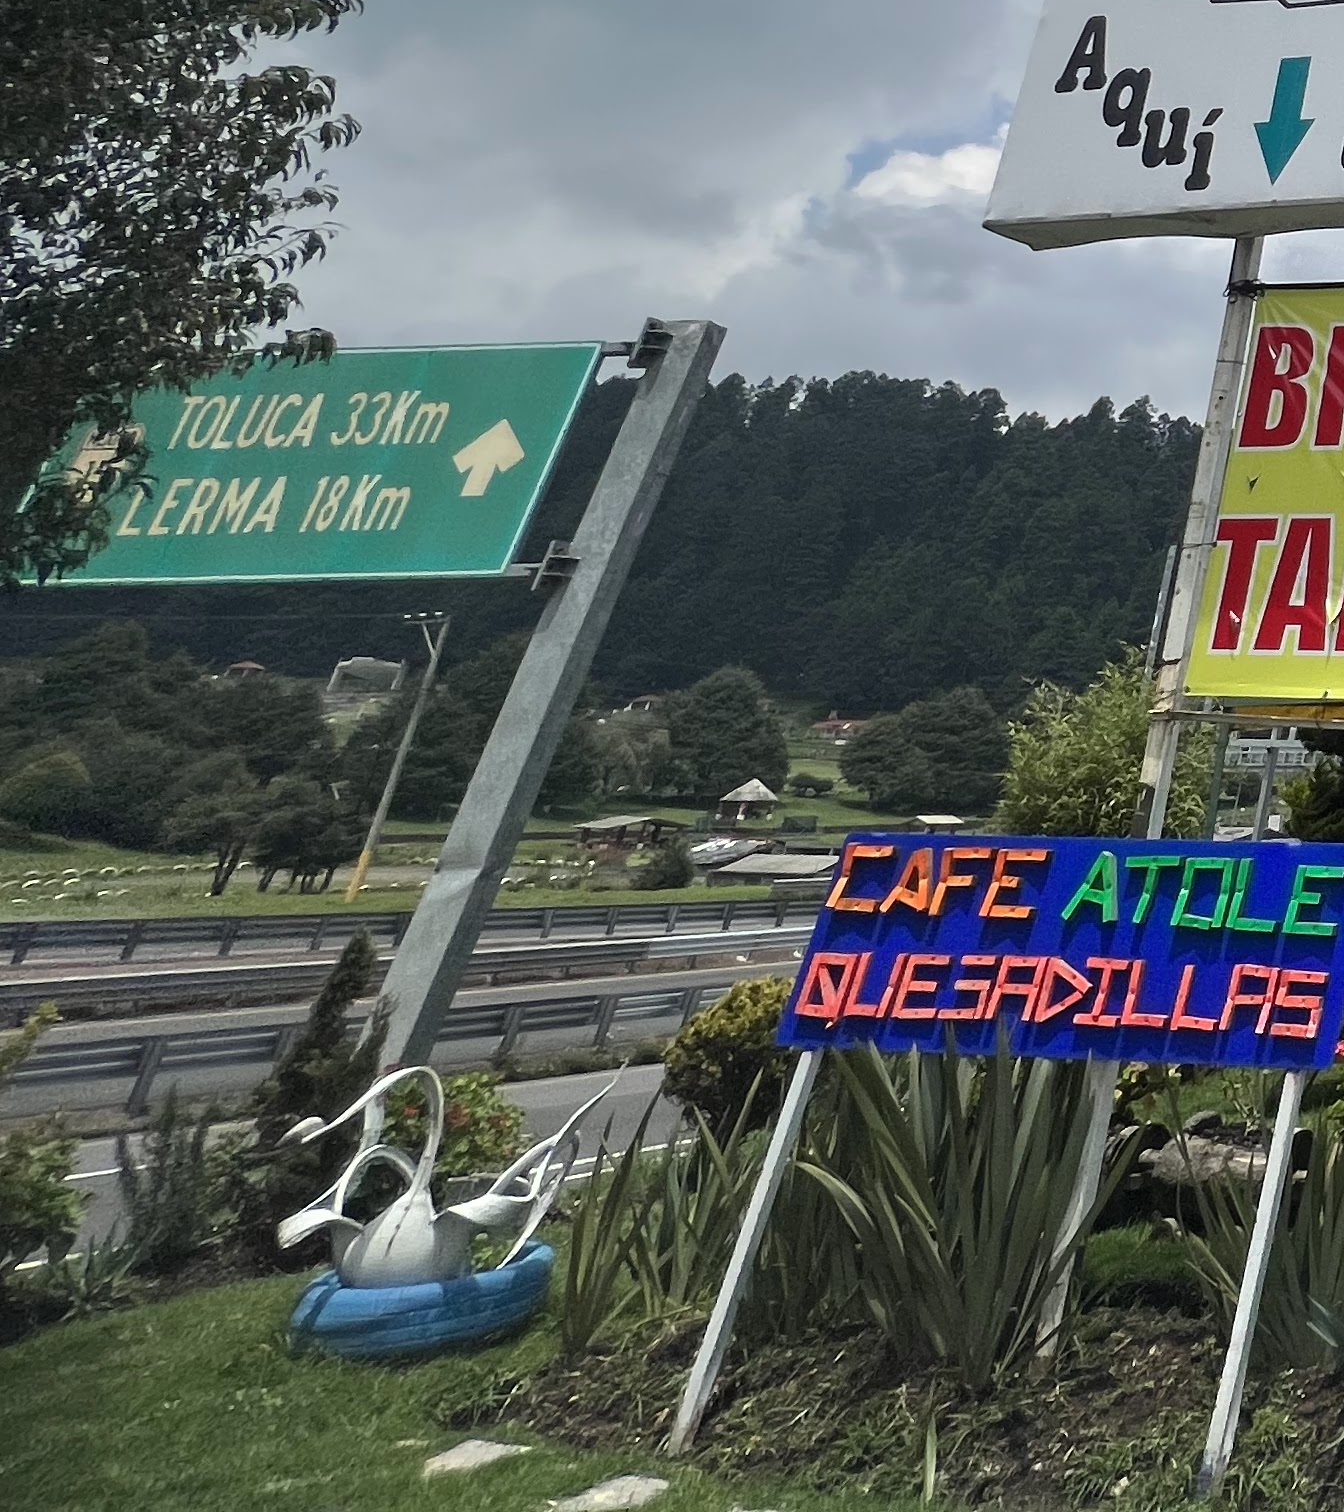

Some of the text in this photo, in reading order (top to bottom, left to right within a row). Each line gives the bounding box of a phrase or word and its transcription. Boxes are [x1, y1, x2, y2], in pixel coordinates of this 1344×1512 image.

[1055, 16, 1223, 190] Aquí
[166, 392, 326, 451] TOLUCA
[116, 475, 288, 536] LERMA
[826, 843, 1051, 919] CAFE
[794, 951, 1330, 1040] QUESADILLAS
